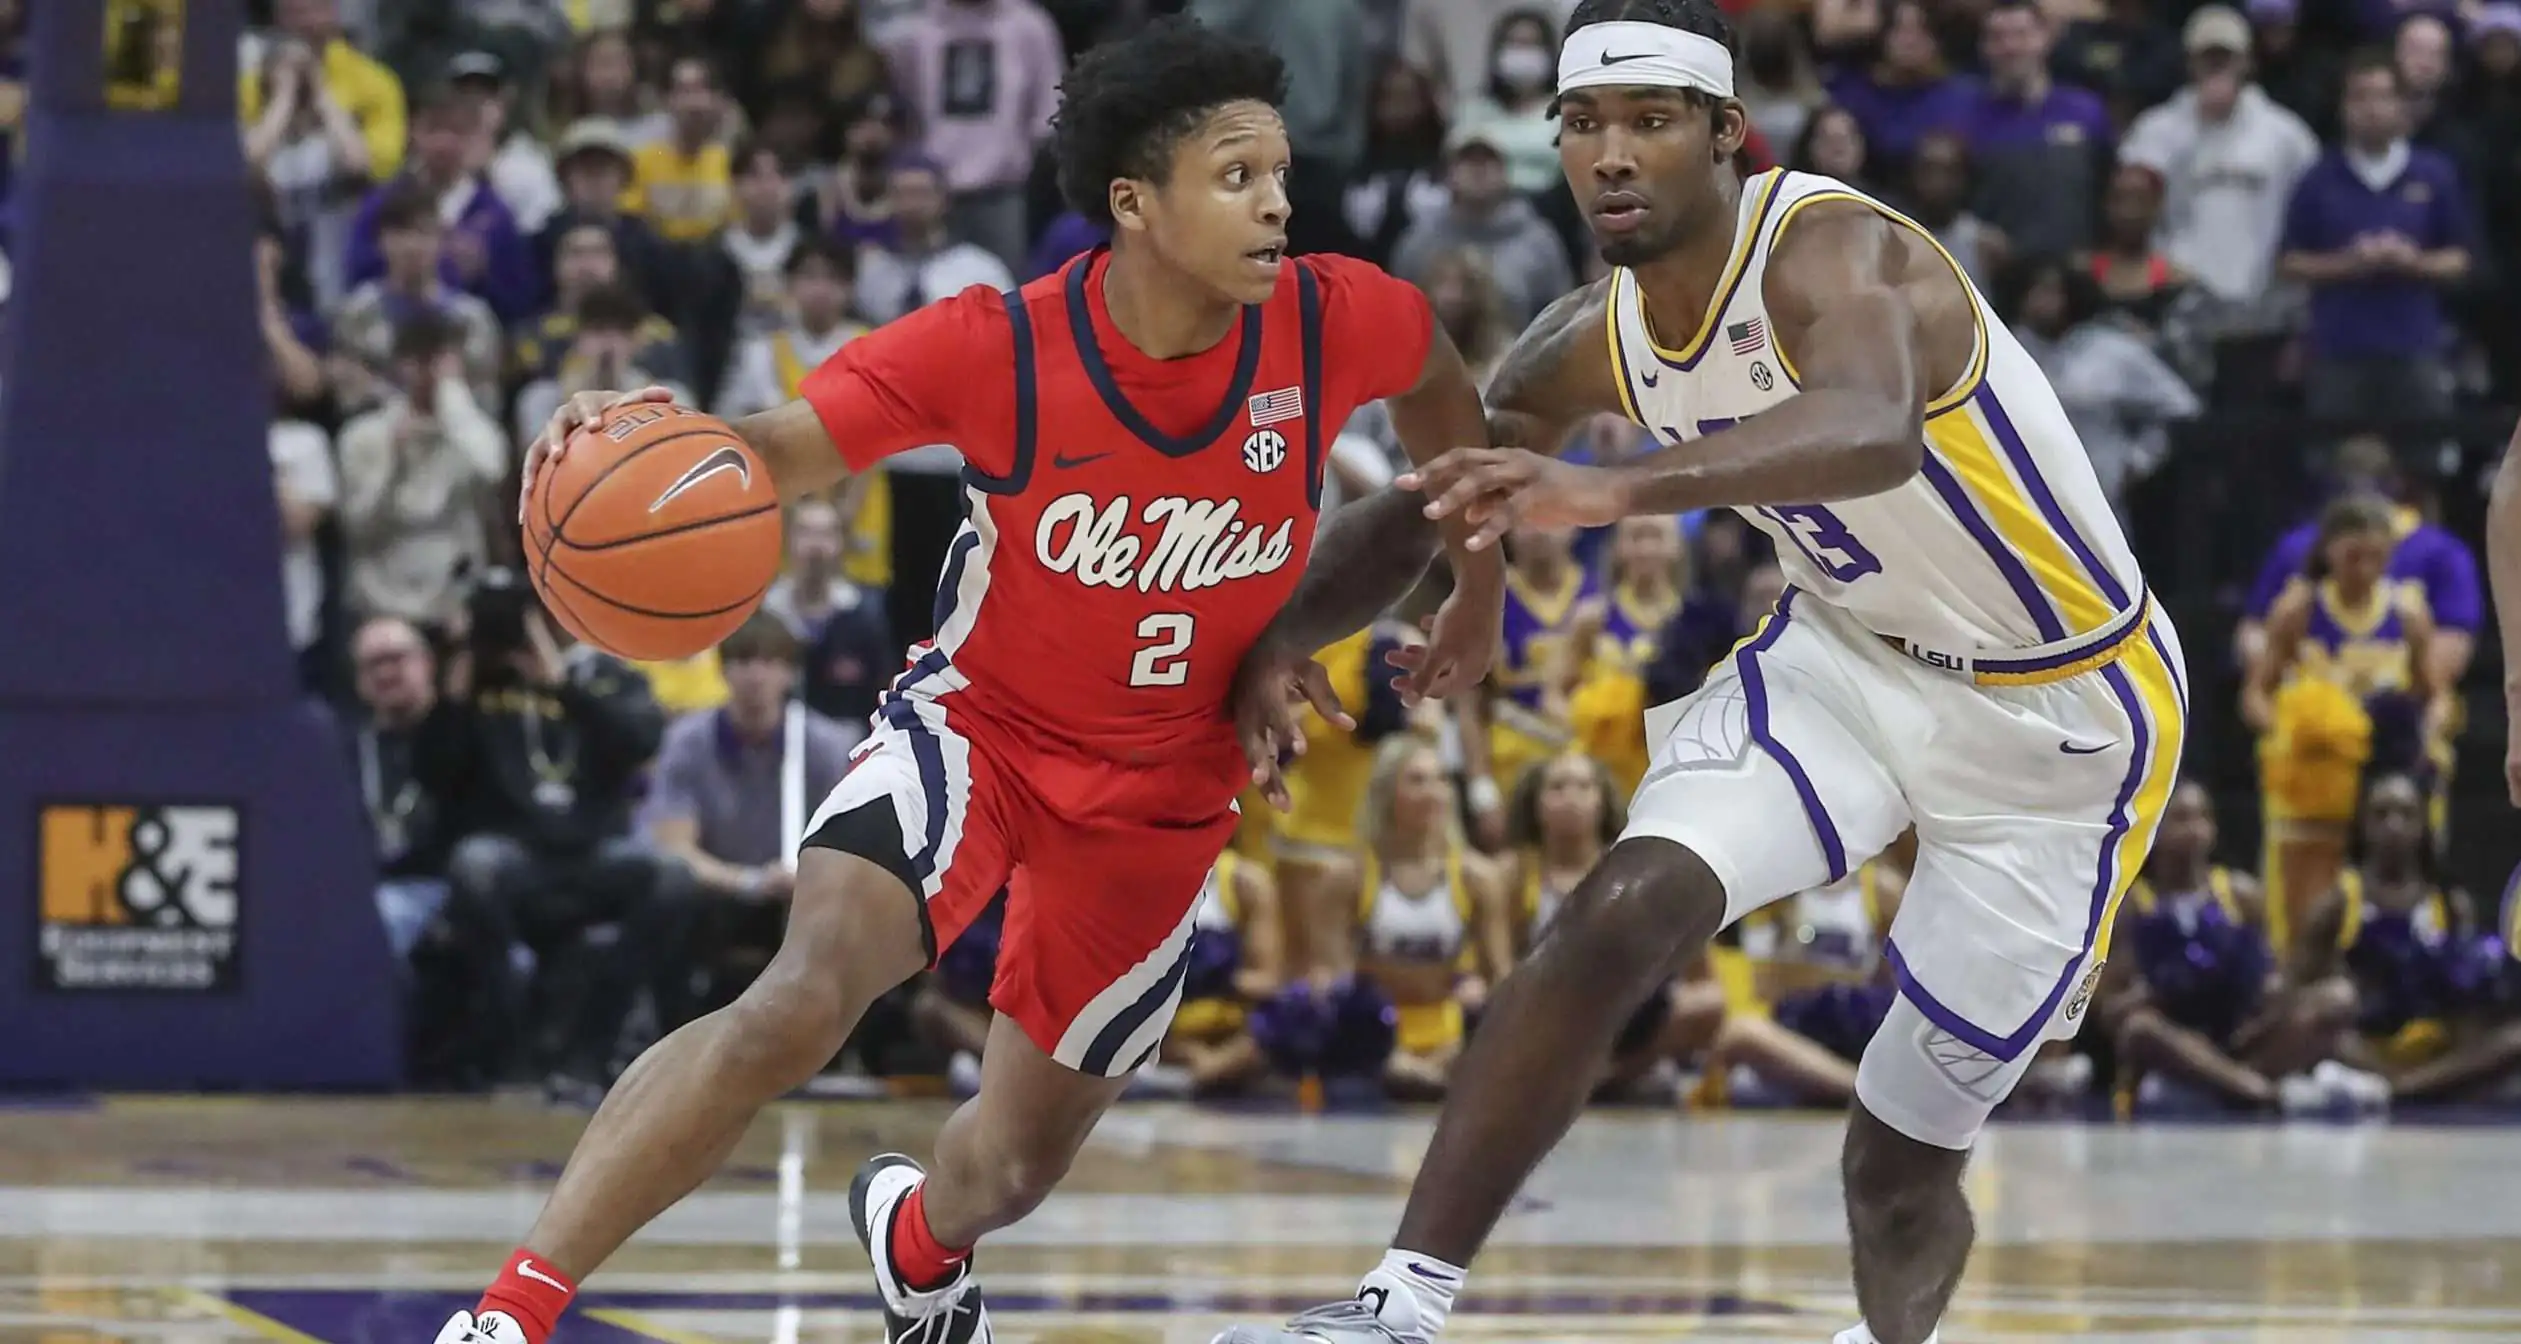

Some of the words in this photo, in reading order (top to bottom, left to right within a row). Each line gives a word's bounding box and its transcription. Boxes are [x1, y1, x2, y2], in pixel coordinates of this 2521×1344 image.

[1243, 429, 1287, 473] SEC
[1035, 491, 1141, 589] Ole
[1137, 496, 1294, 593] Miss
[1128, 612, 1195, 688] 2
[1912, 644, 1964, 672] LSU
[42, 806, 237, 924] H&E
